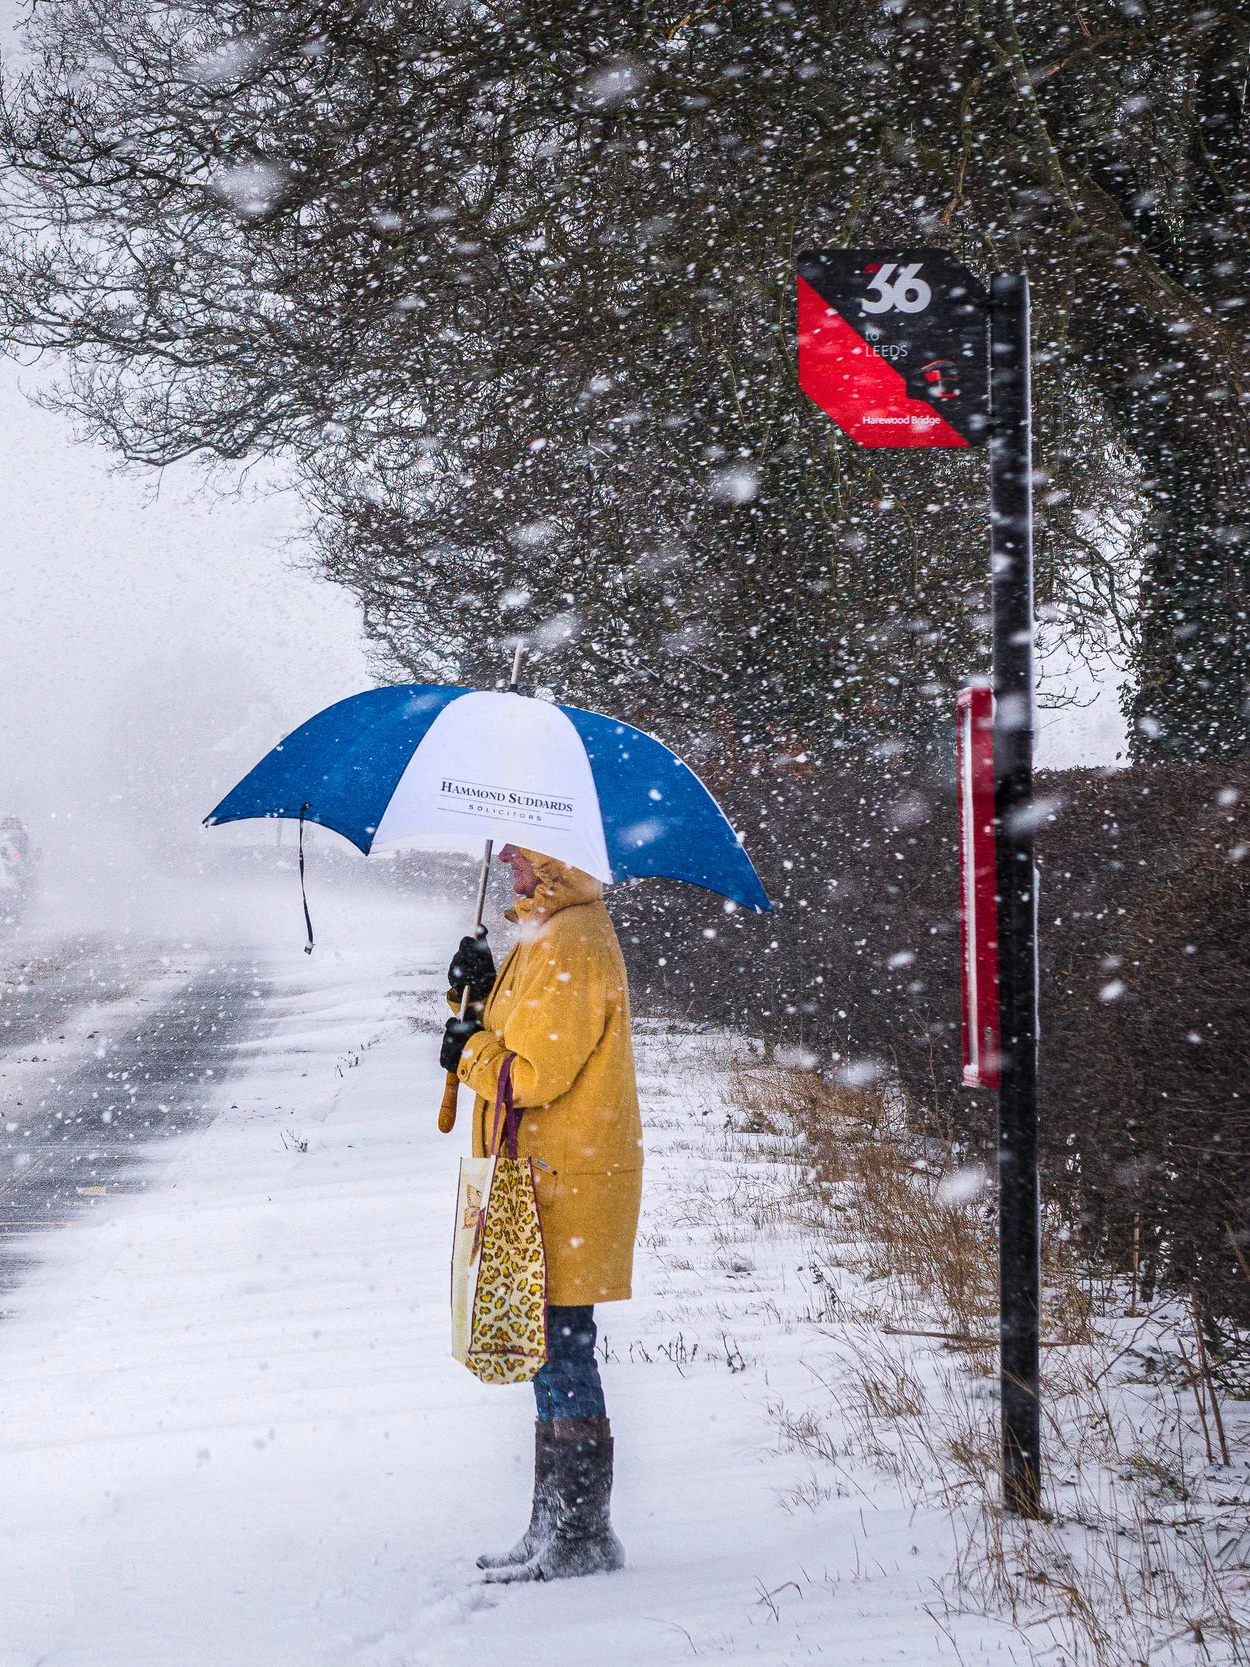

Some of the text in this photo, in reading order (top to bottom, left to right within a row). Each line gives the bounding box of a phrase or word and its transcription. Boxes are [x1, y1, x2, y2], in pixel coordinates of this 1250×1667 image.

[861, 263, 932, 314] 36
[865, 331, 880, 341] to
[865, 345, 908, 357] LEEDS
[862, 415, 941, 426] Harewood Bridge
[441, 781, 573, 812] HAMMOND SUDDARDS
[468, 804, 542, 821] SOLICITORS
